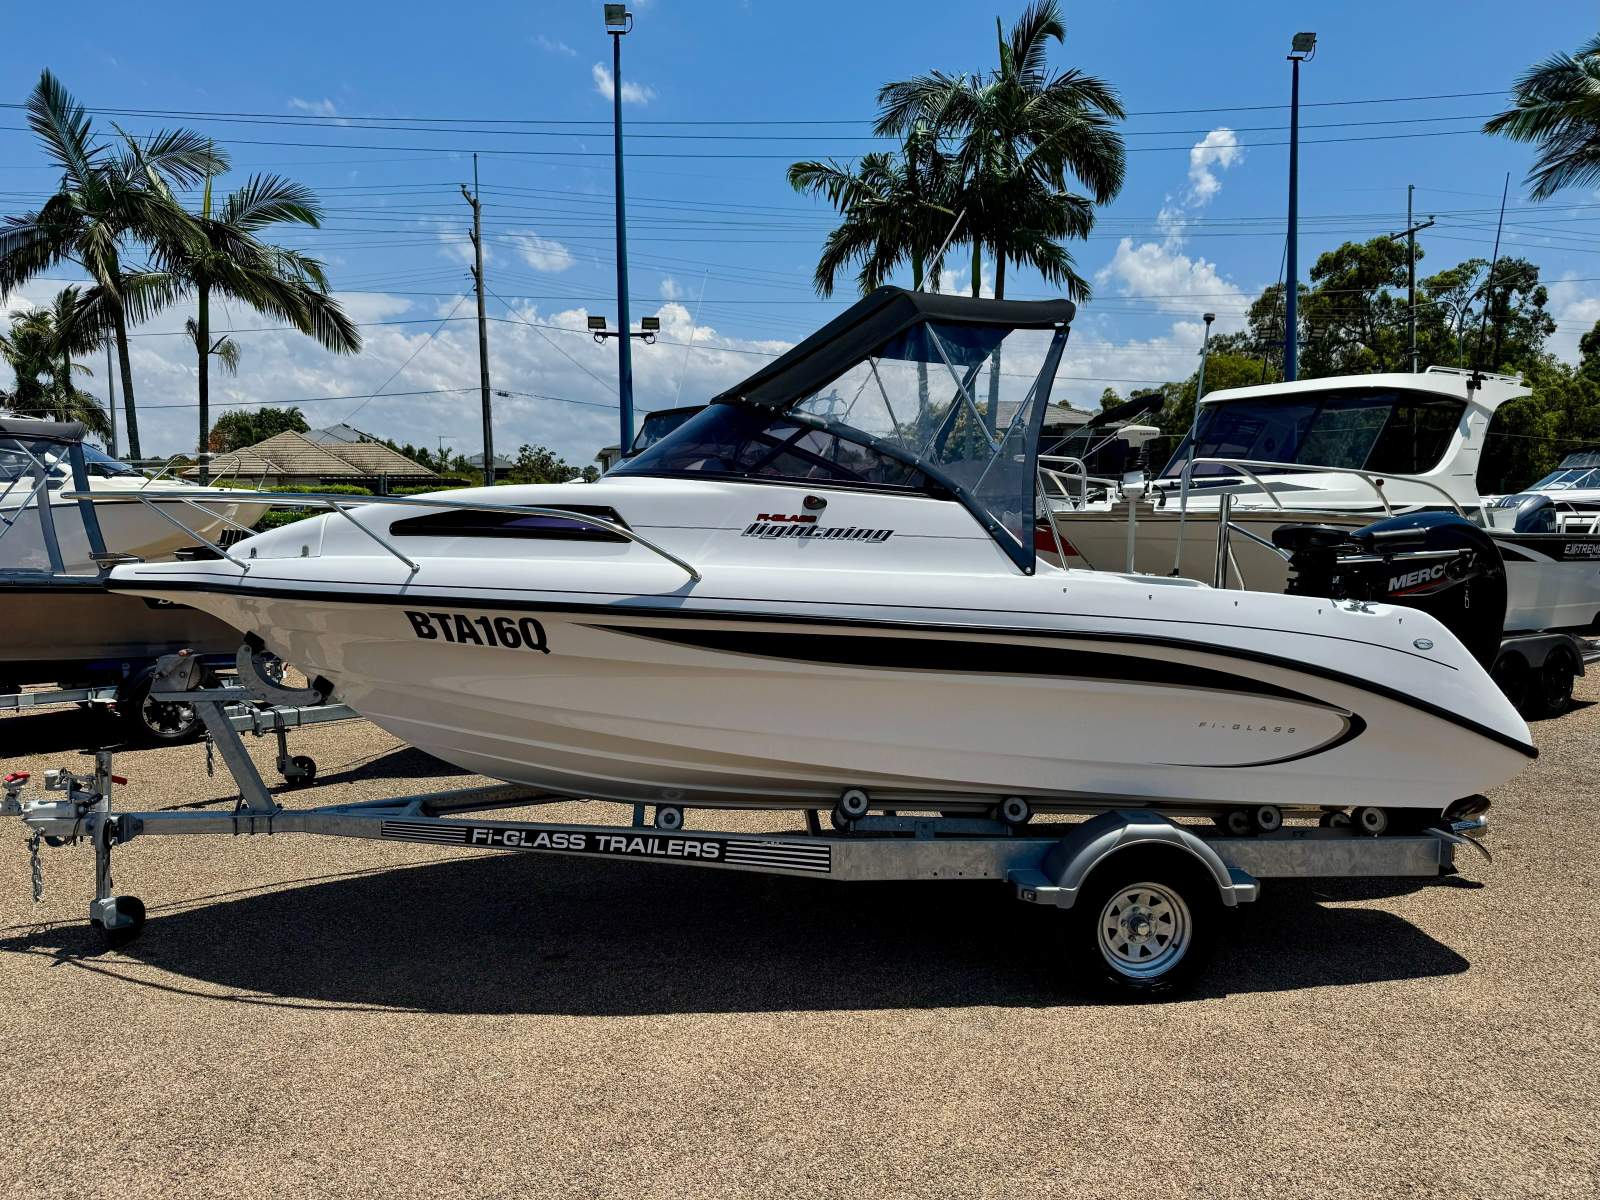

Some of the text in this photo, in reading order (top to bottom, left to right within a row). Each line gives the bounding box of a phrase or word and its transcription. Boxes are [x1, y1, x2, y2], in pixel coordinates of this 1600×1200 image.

[741, 522, 895, 543] lightning
[1564, 543, 1600, 554] EXTREM
[1387, 561, 1449, 592] MERC
[404, 610, 551, 655] BTA16Q
[596, 835, 720, 858] TRAILERS
